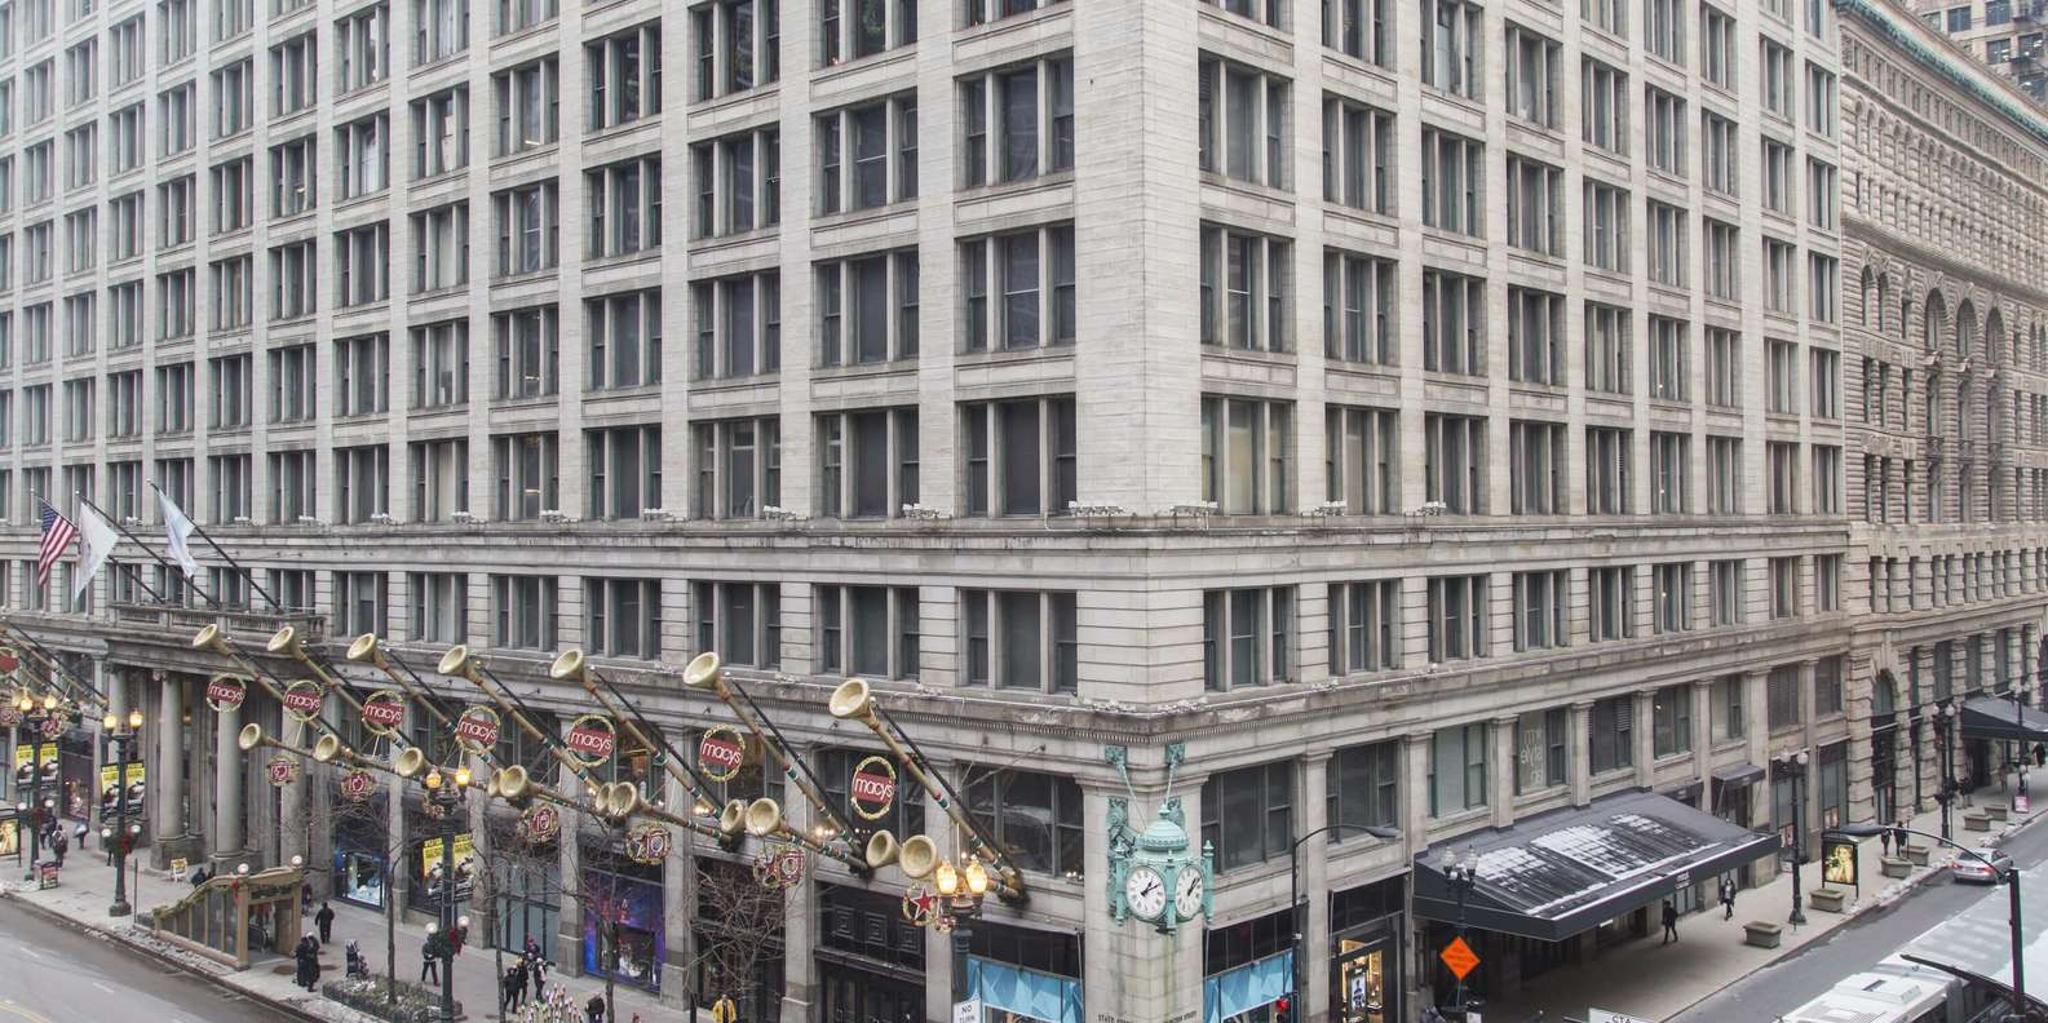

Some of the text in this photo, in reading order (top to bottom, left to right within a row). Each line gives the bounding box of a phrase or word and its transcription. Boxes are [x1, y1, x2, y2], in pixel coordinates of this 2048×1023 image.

[570, 731, 613, 752] macy's
[702, 742, 741, 766] macy's
[854, 777, 894, 801] macy's
